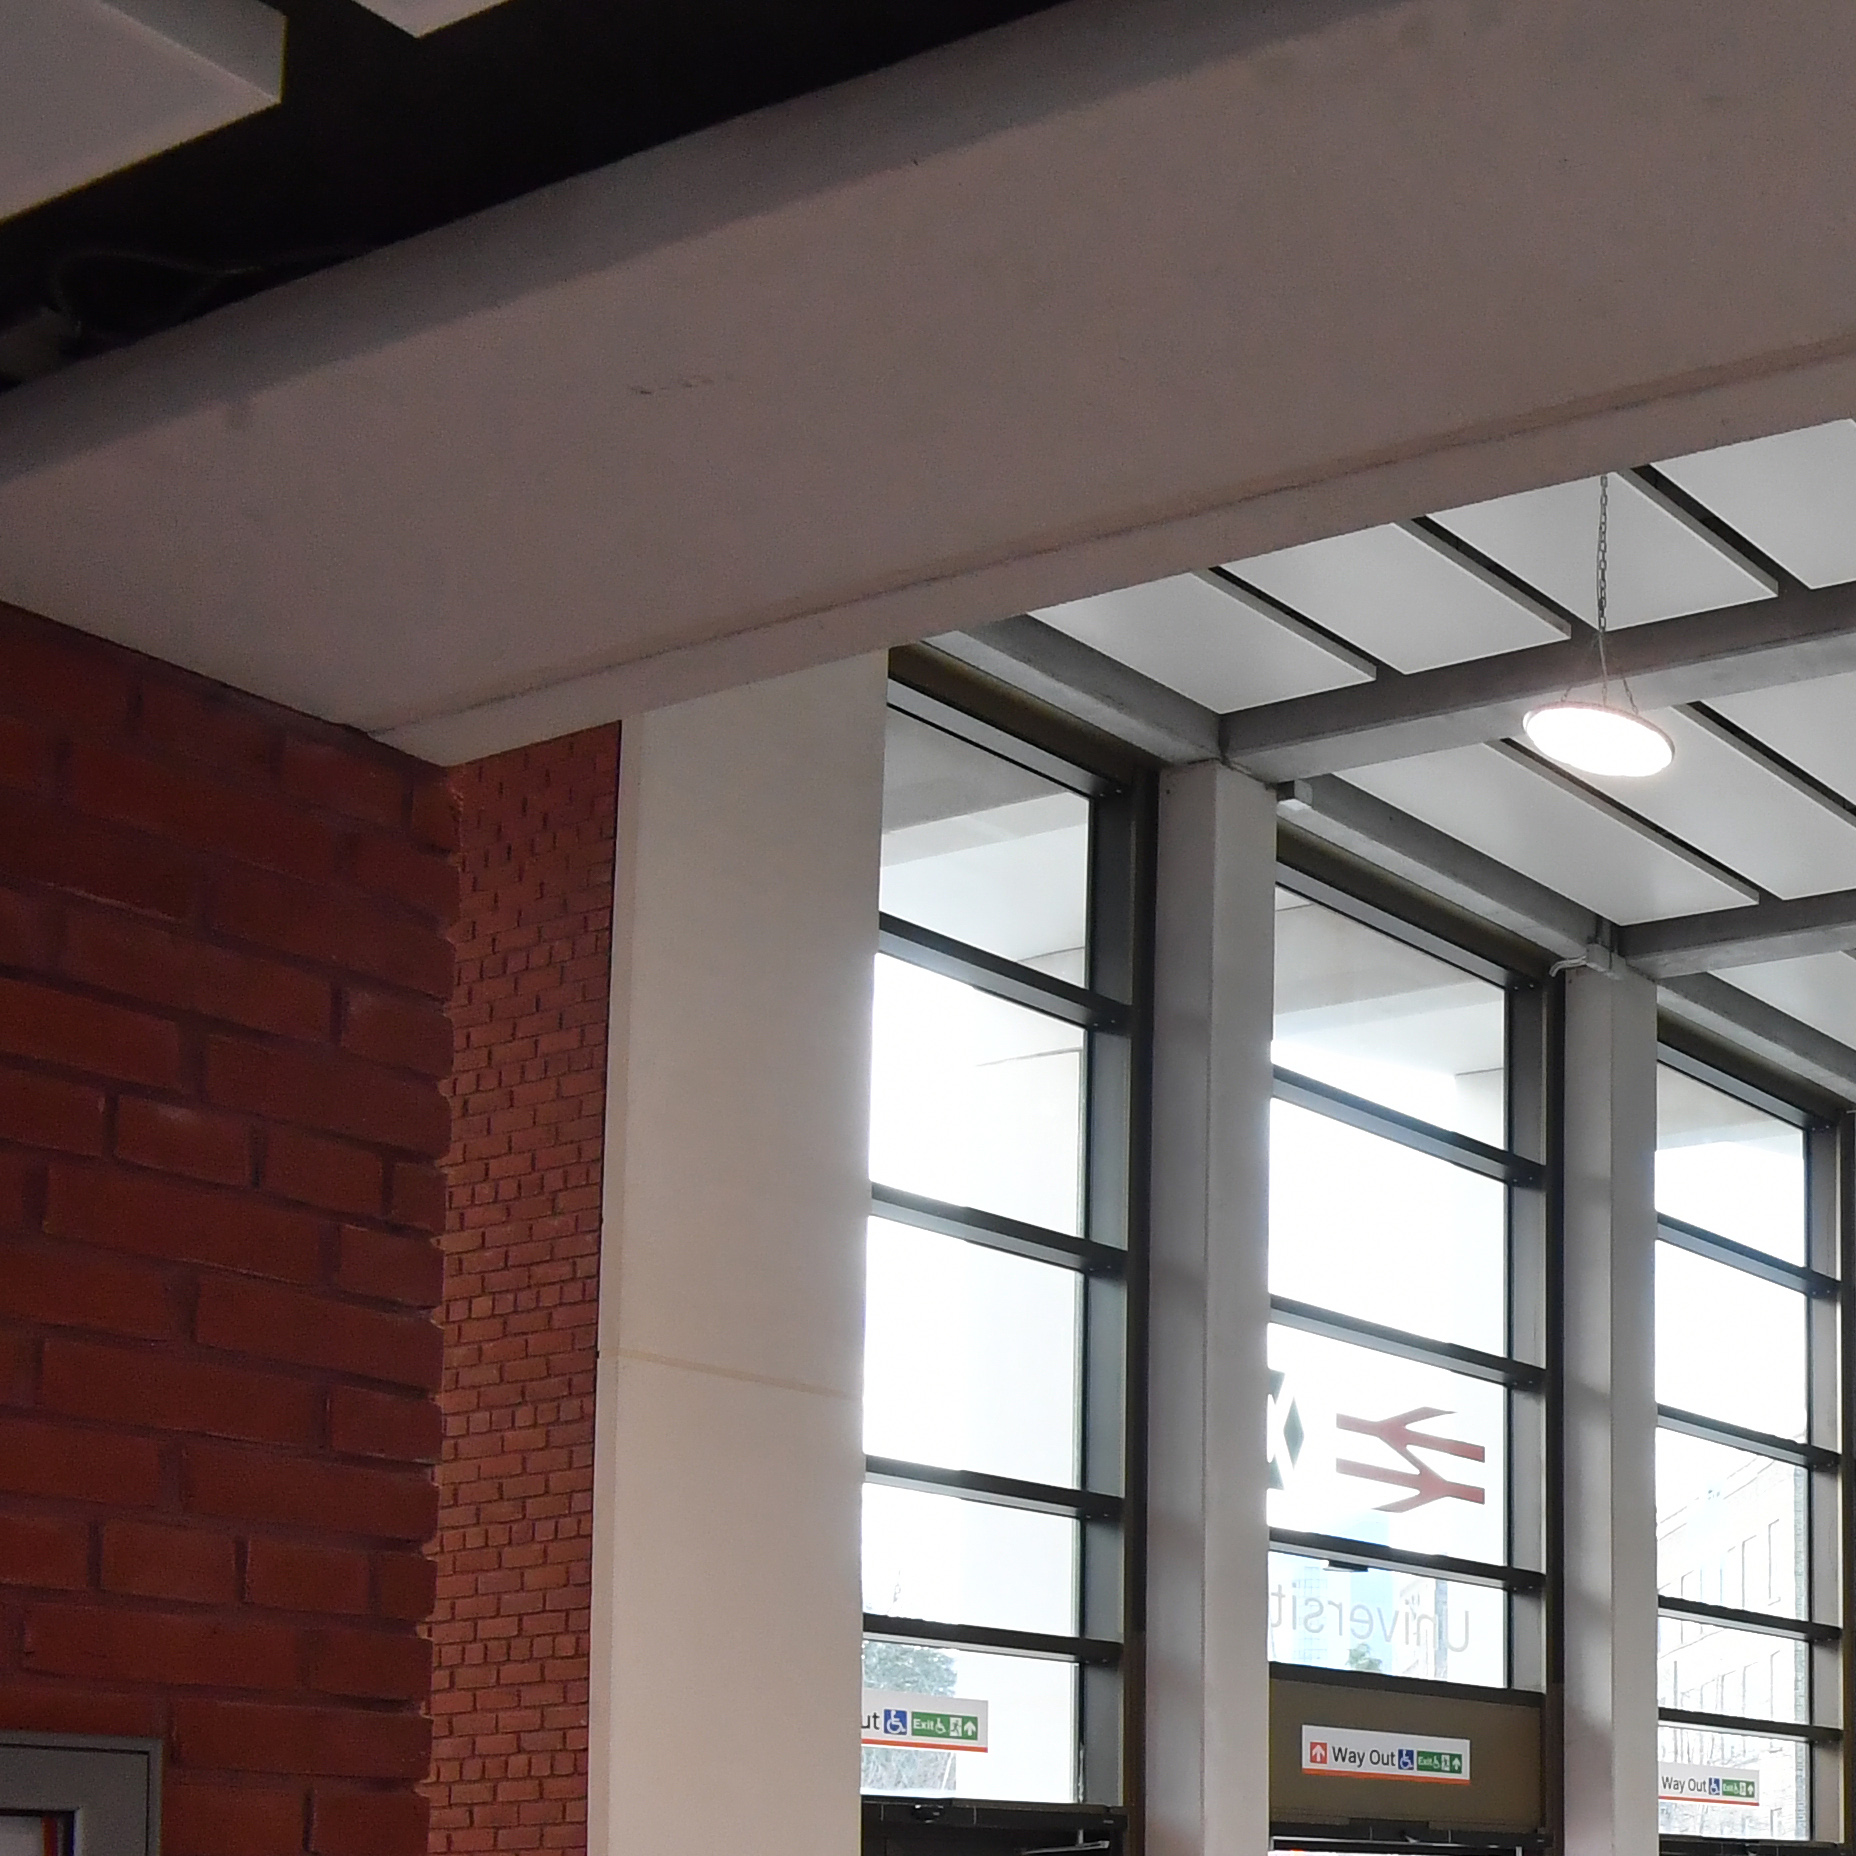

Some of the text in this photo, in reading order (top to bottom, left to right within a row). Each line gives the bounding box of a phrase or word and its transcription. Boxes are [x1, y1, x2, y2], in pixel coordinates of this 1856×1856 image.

[913, 1718, 934, 1731] Exit
[1331, 1745, 1433, 1769] Way Out Exit
[1661, 1775, 1686, 1794] Way
[1687, 1778, 1708, 1793] Out
